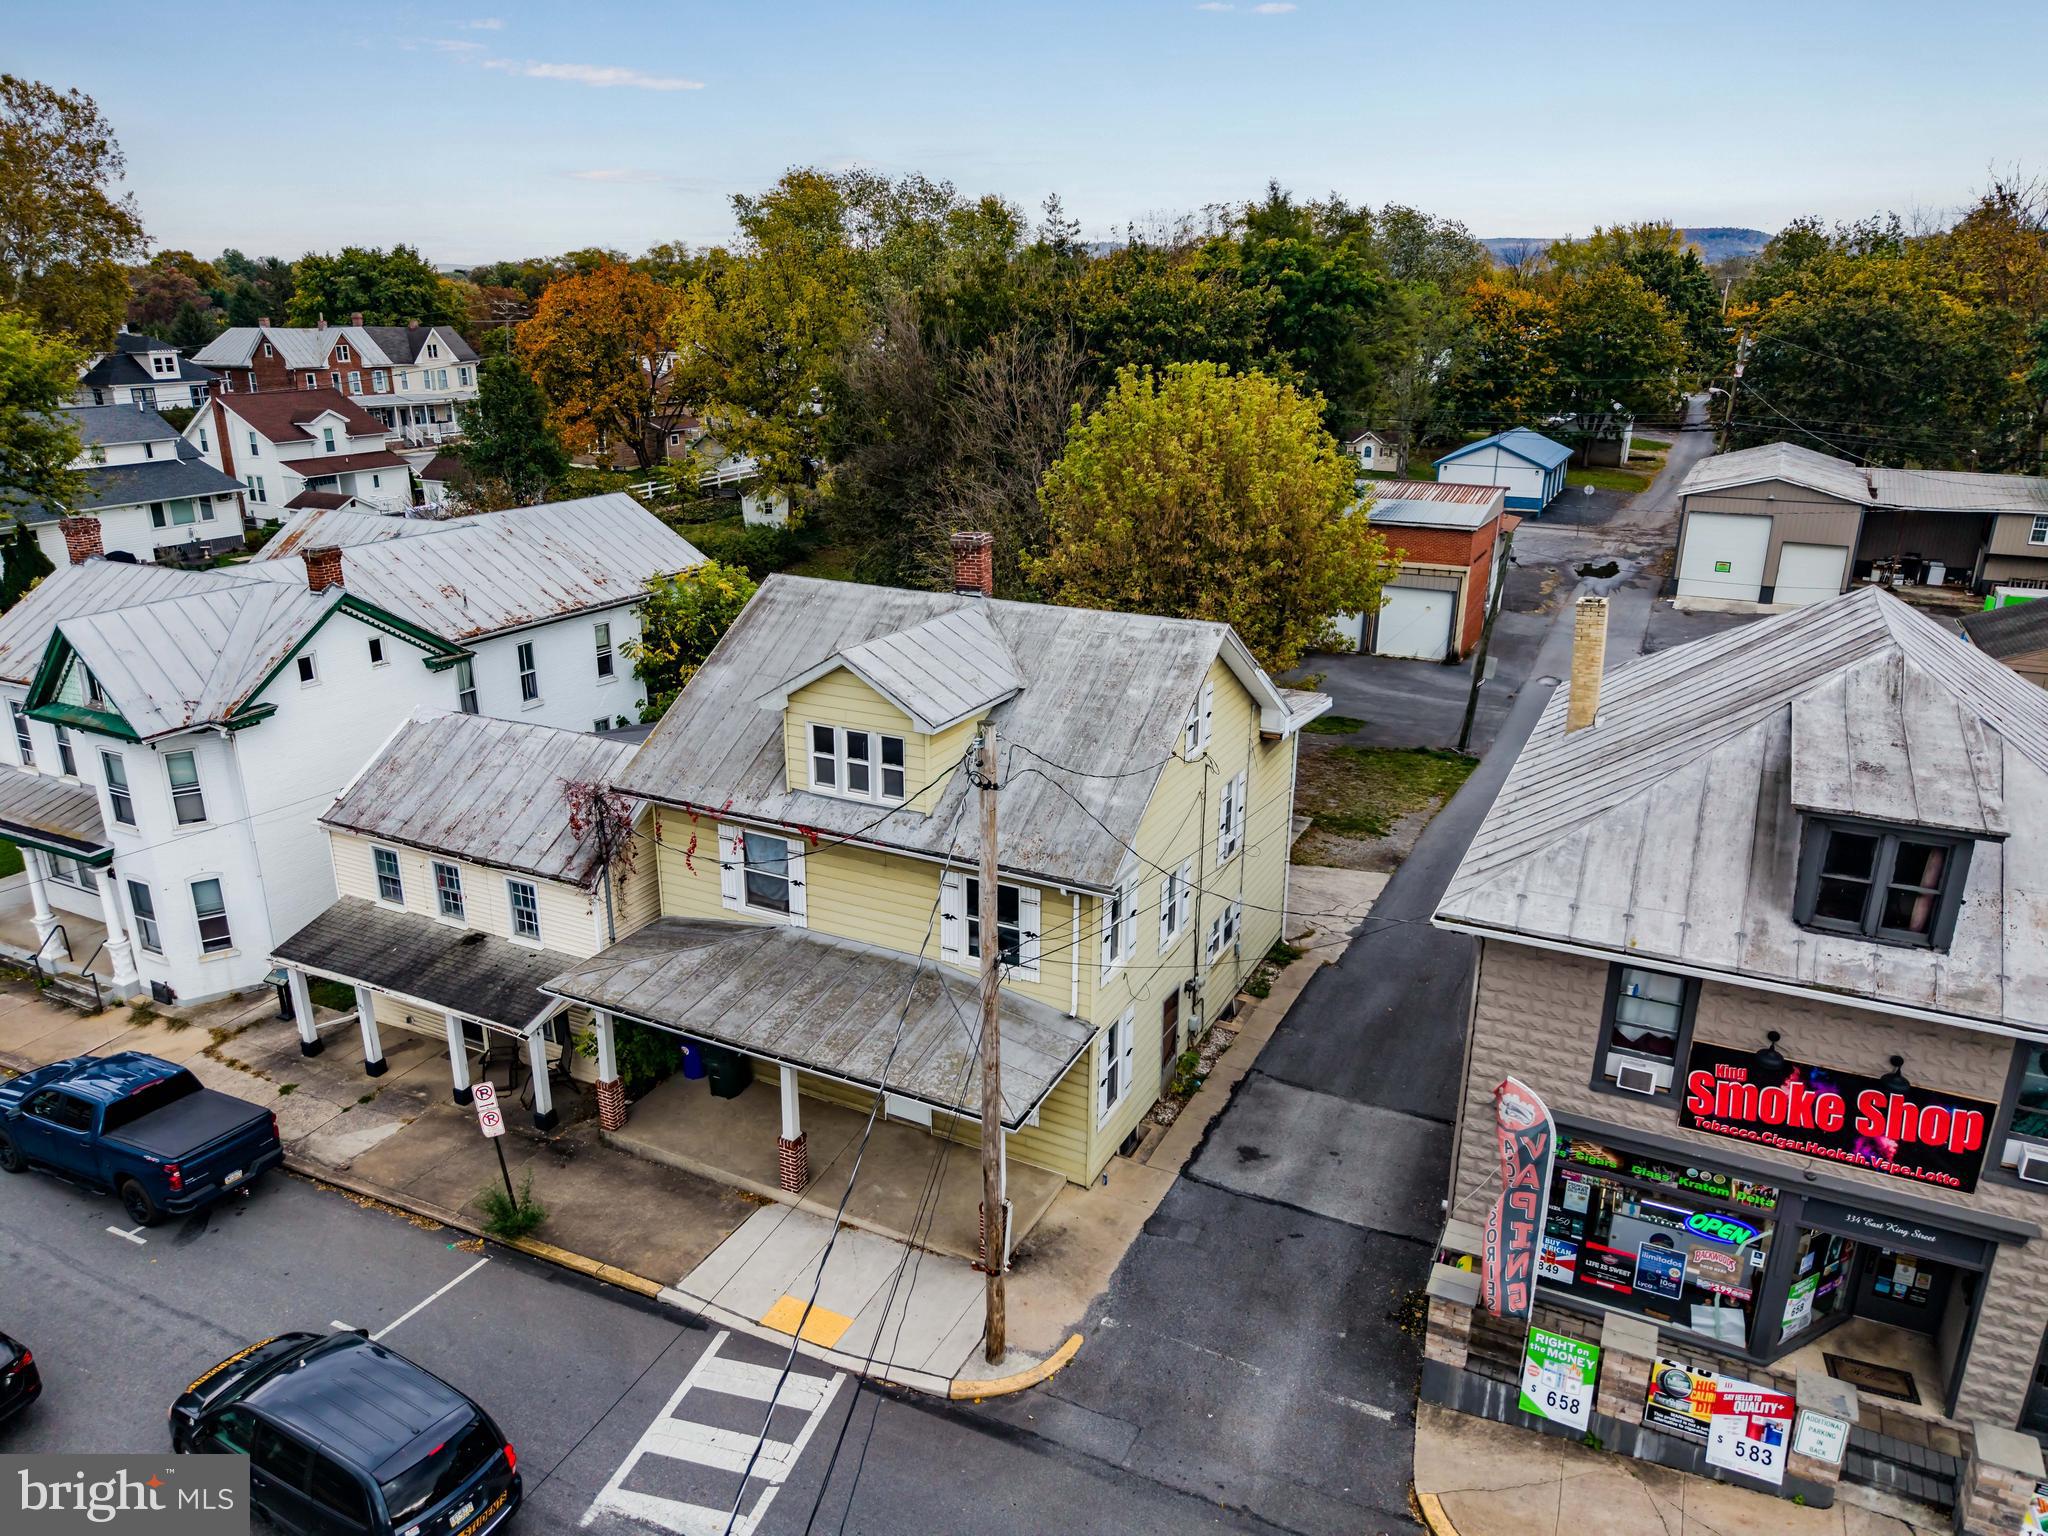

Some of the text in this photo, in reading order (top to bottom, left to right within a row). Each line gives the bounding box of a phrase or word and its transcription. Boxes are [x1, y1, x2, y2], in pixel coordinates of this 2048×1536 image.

[1715, 1063, 1748, 1082] King
[1686, 1069, 1985, 1154] Smoke Shop
[1575, 1150, 1617, 1169] Cigars
[1631, 1164, 1671, 1183] Glass
[1678, 1176, 1730, 1197] Kratom
[1736, 1190, 1776, 1208] Delta
[1689, 1213, 1752, 1245] OPEN
[1844, 1213, 1936, 1243] 334 East King Street
[1544, 1237, 1560, 1247] BUY
[1544, 1243, 1572, 1257] ERICAN
[1585, 1259, 1600, 1269] LIFE
[1600, 1263, 1608, 1271] IS
[1609, 1266, 1631, 1277] SWEET
[1641, 1251, 1683, 1268] ilimitados
[1693, 1250, 1737, 1273] BACKWOODS
[1535, 1333, 1590, 1357] RIGHT on
[1529, 1342, 1596, 1370] the MONEY
[1696, 1380, 1717, 1392] HIG
[1690, 1390, 1716, 1403] CALIB
[1723, 1393, 1762, 1403] SAY HELLO TO
[1695, 1402, 1711, 1414] DI
[1805, 1415, 1842, 1431] ADDITIONAL
[1808, 1427, 1836, 1440] PARKING
[1809, 1446, 1826, 1457] BACK
